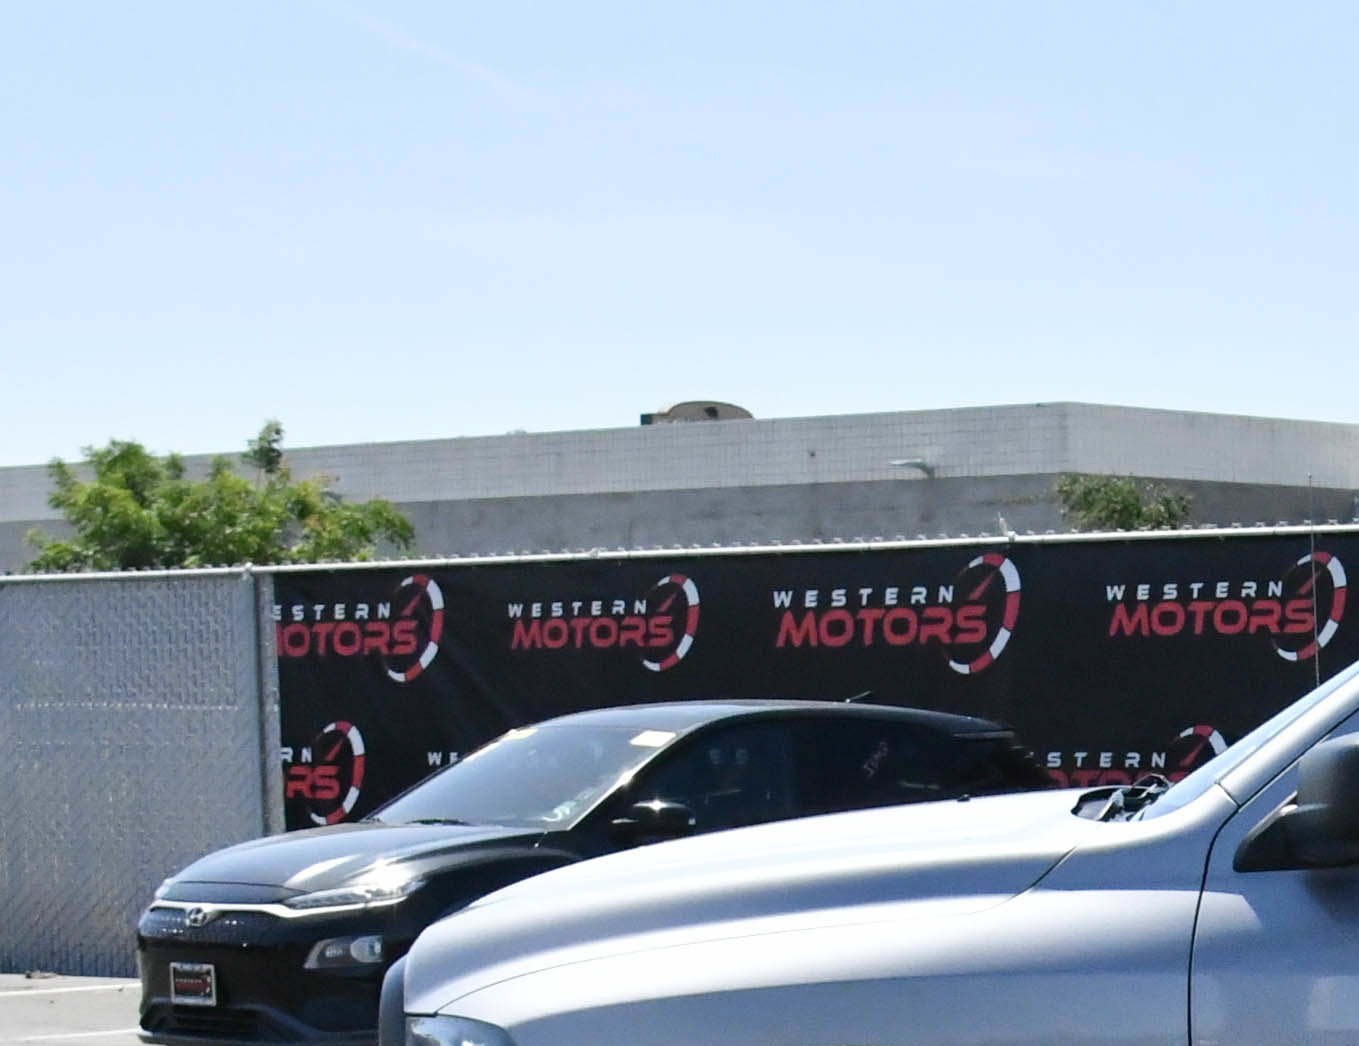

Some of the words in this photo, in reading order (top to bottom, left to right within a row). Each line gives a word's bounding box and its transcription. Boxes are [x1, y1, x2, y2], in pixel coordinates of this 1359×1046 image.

[773, 585, 954, 608] WESTERN
[1106, 580, 1283, 601] WESTERN
[508, 600, 647, 618] WESTERN
[1109, 599, 1316, 637] MOTORS
[512, 615, 674, 649] MOTORS
[776, 605, 987, 647] MOTORS
